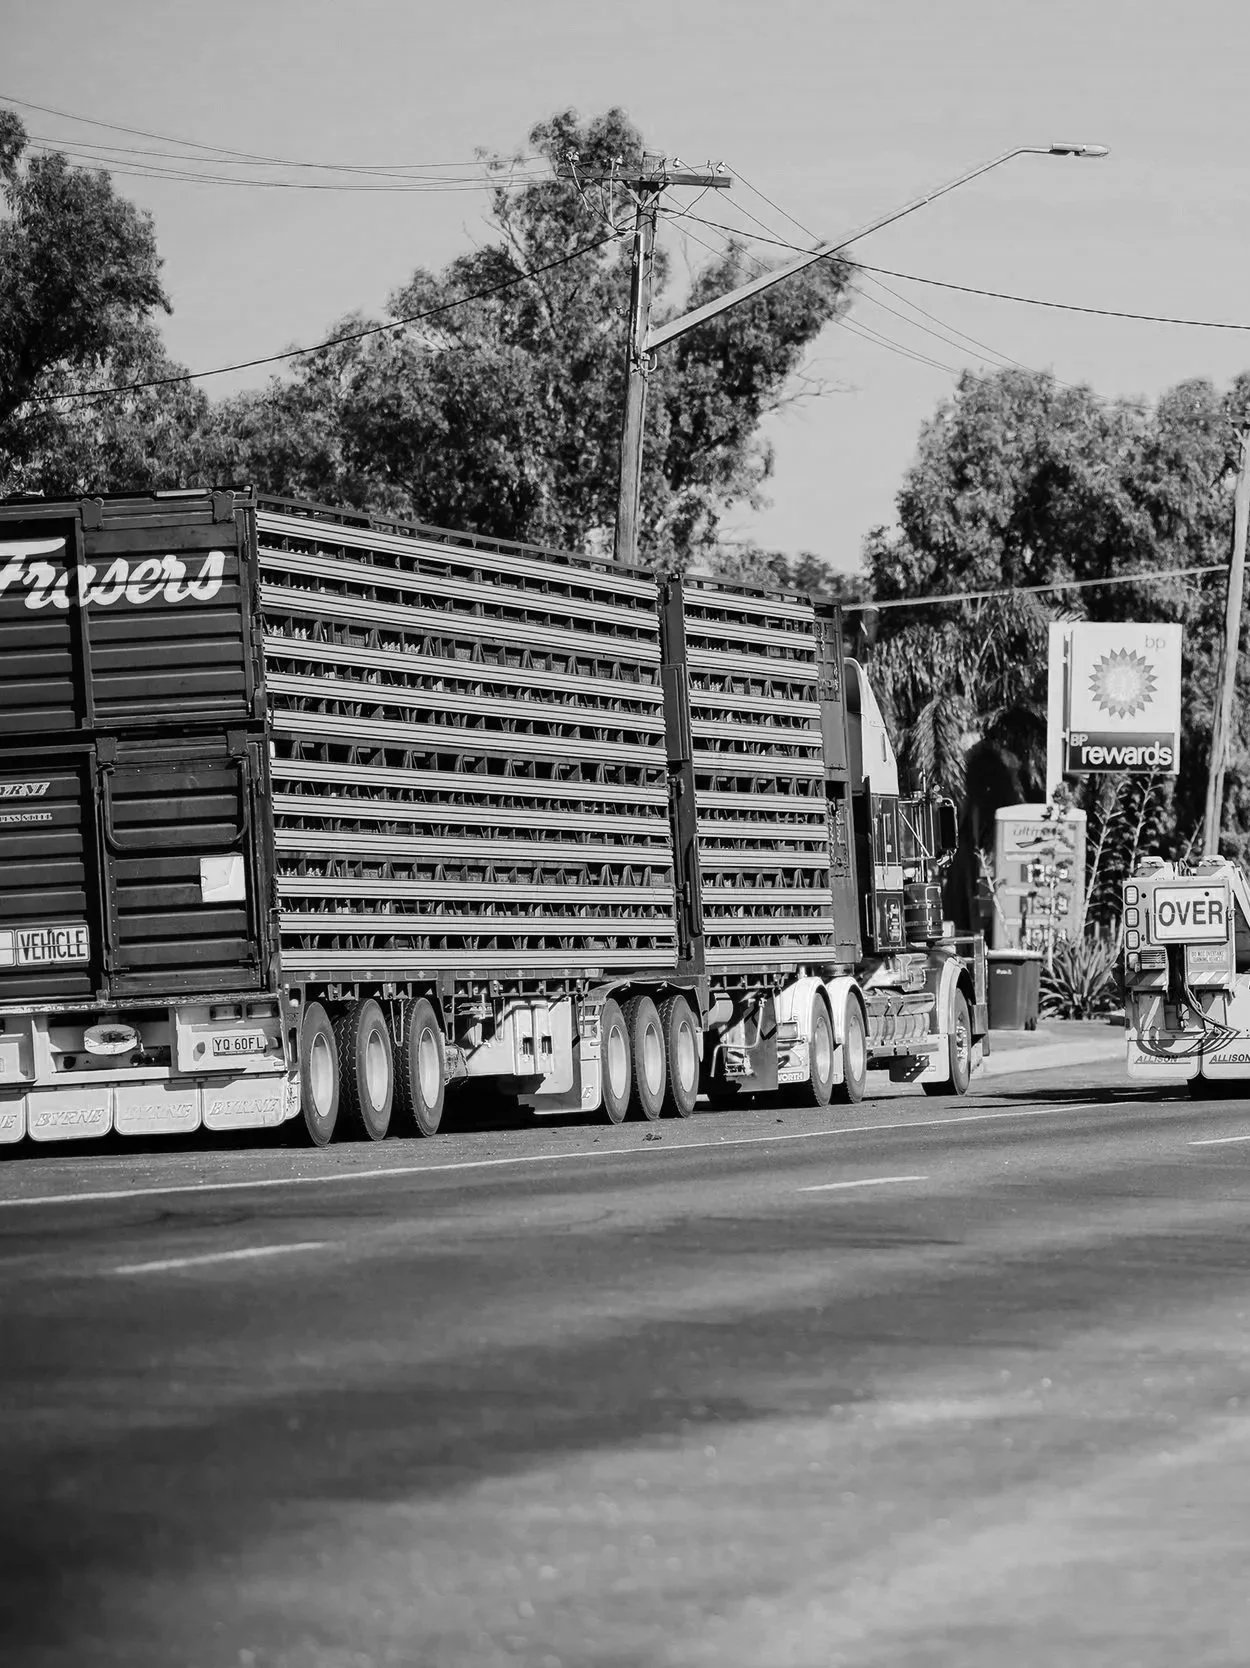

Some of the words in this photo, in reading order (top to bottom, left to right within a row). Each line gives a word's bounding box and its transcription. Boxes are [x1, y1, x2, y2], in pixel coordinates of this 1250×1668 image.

[0, 536, 225, 609] Frasers
[1145, 634, 1166, 652] bp
[1070, 733, 1088, 746] BP
[1081, 740, 1172, 766] rewards
[1158, 900, 1223, 927] OVER
[20, 928, 86, 961] VEHICLE
[35, 1109, 104, 1127] BYRNE
